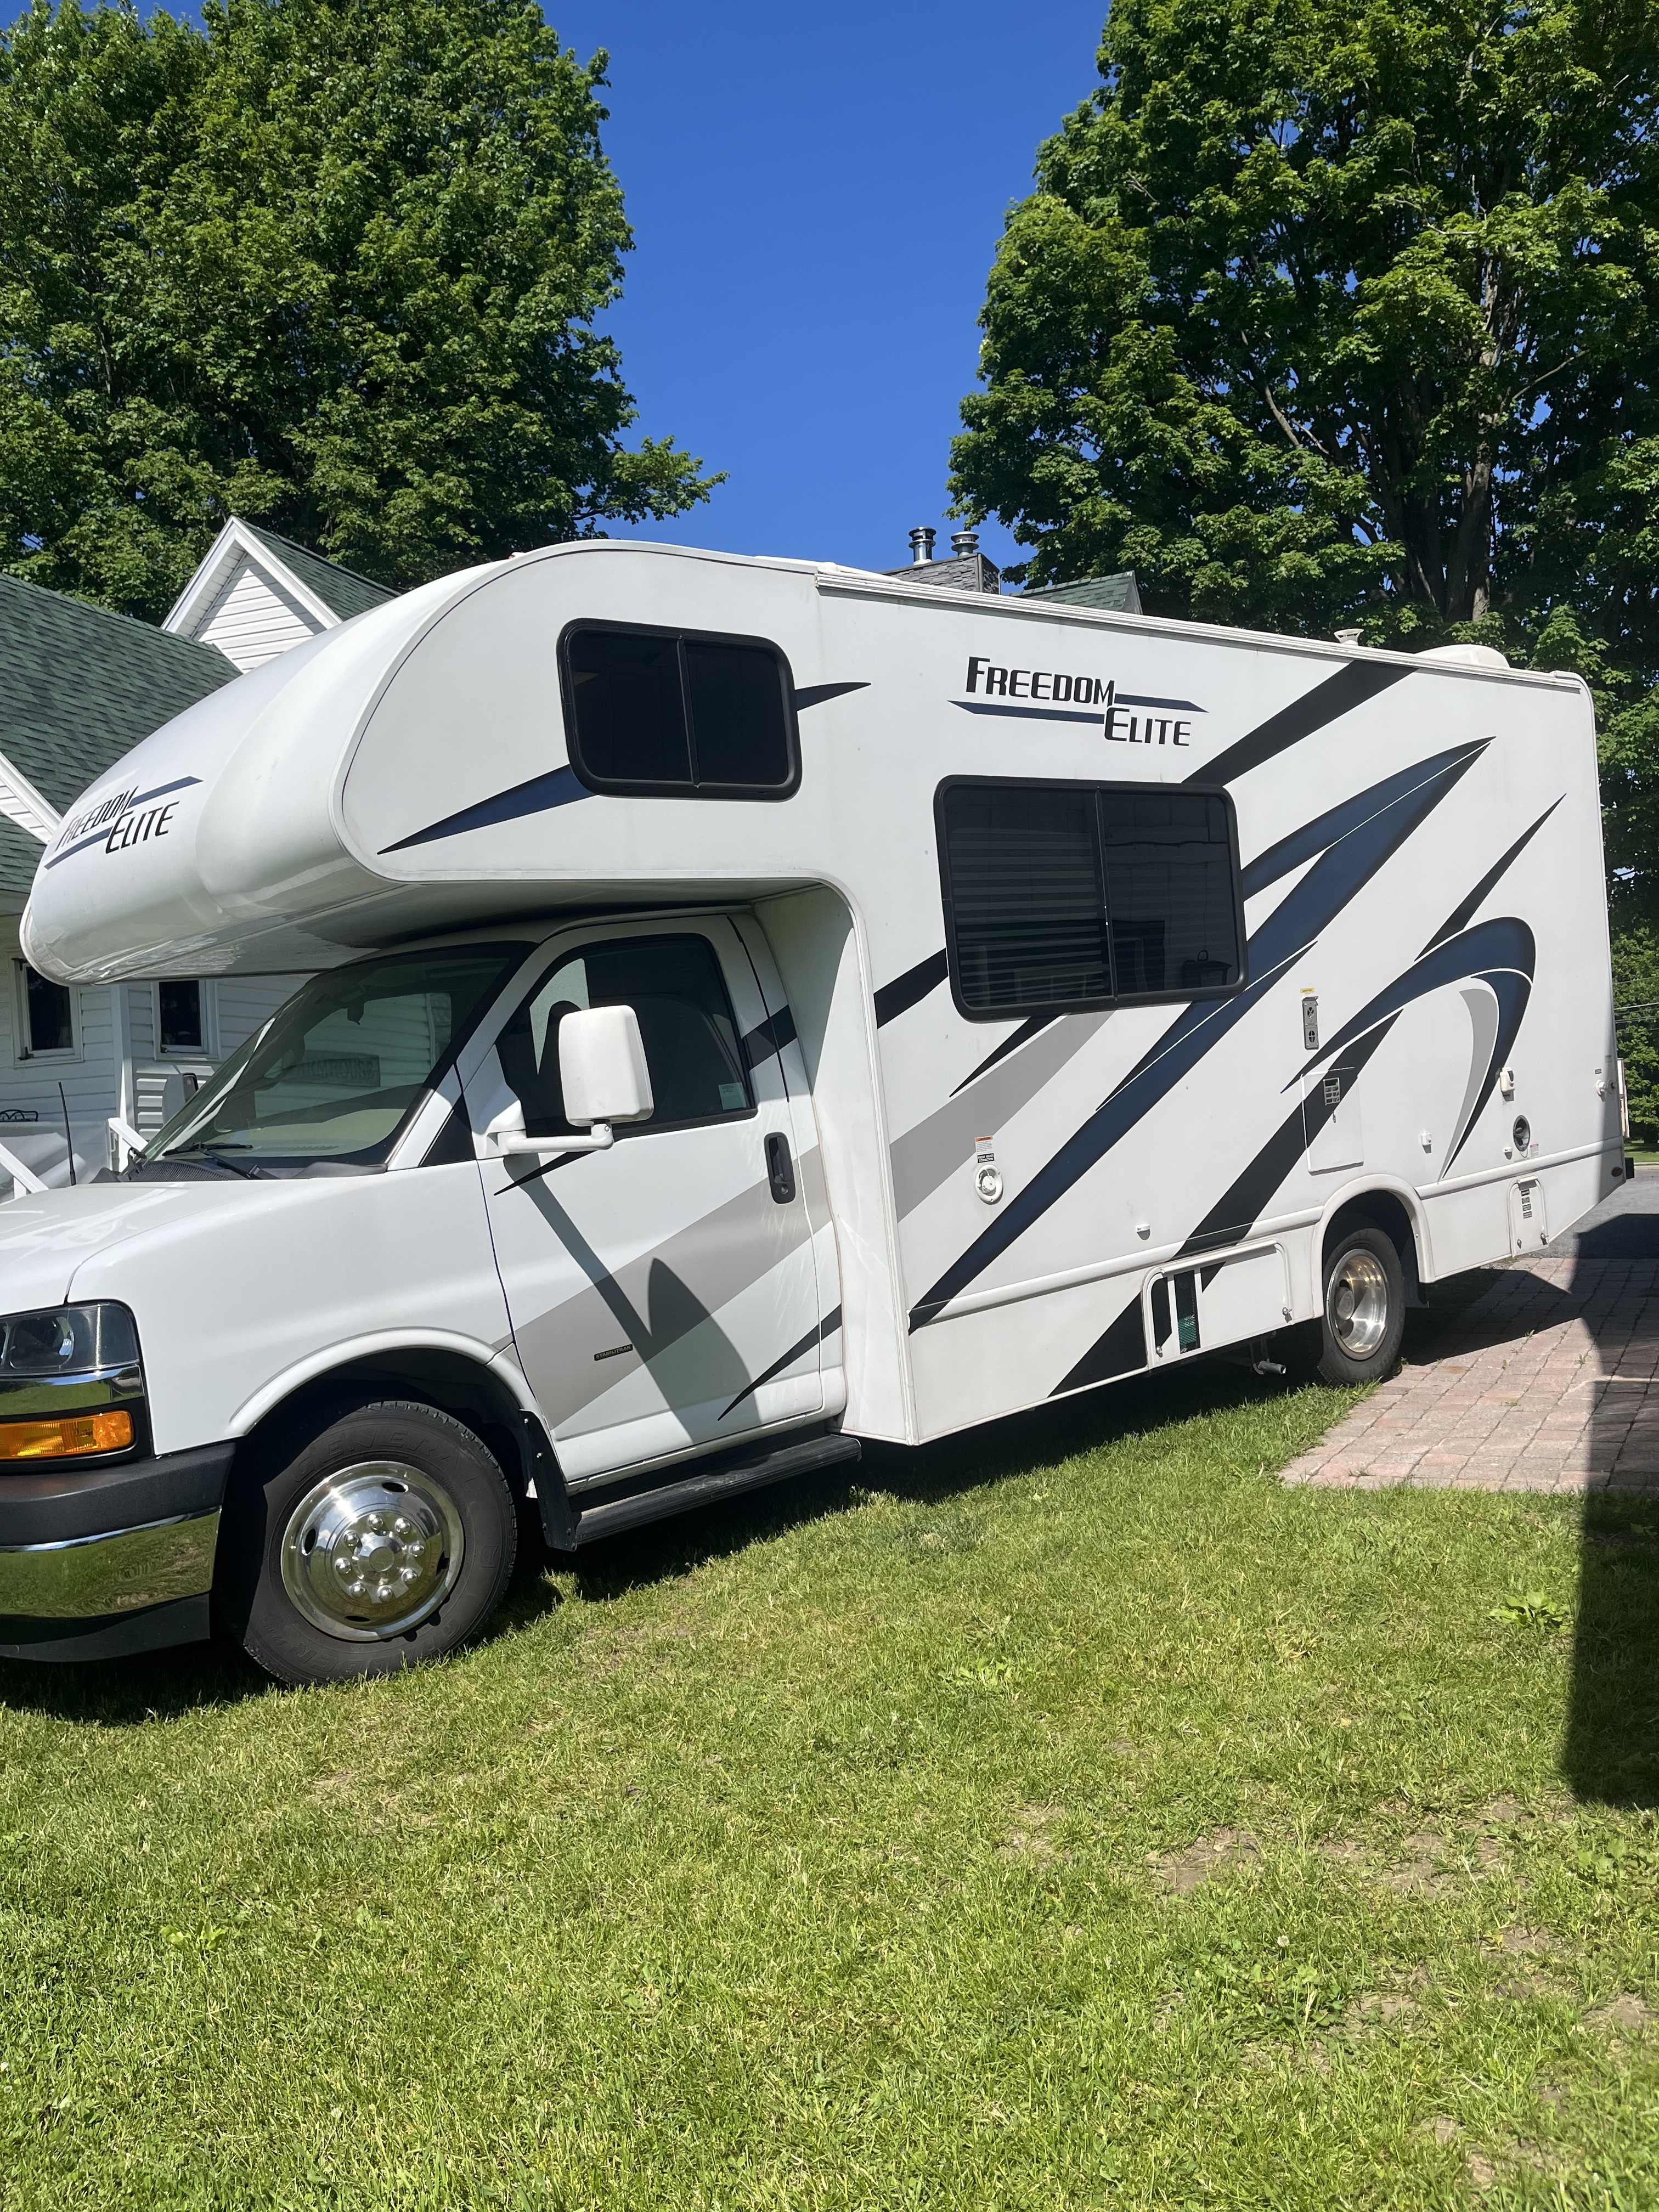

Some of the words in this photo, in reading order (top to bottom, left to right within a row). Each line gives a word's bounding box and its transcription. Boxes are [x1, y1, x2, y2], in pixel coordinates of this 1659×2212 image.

[966, 656, 1115, 707] FREEDOM
[1104, 707, 1192, 746] ELITE
[105, 800, 180, 854] ELITE
[595, 1345, 631, 1358] STABILITRAK
